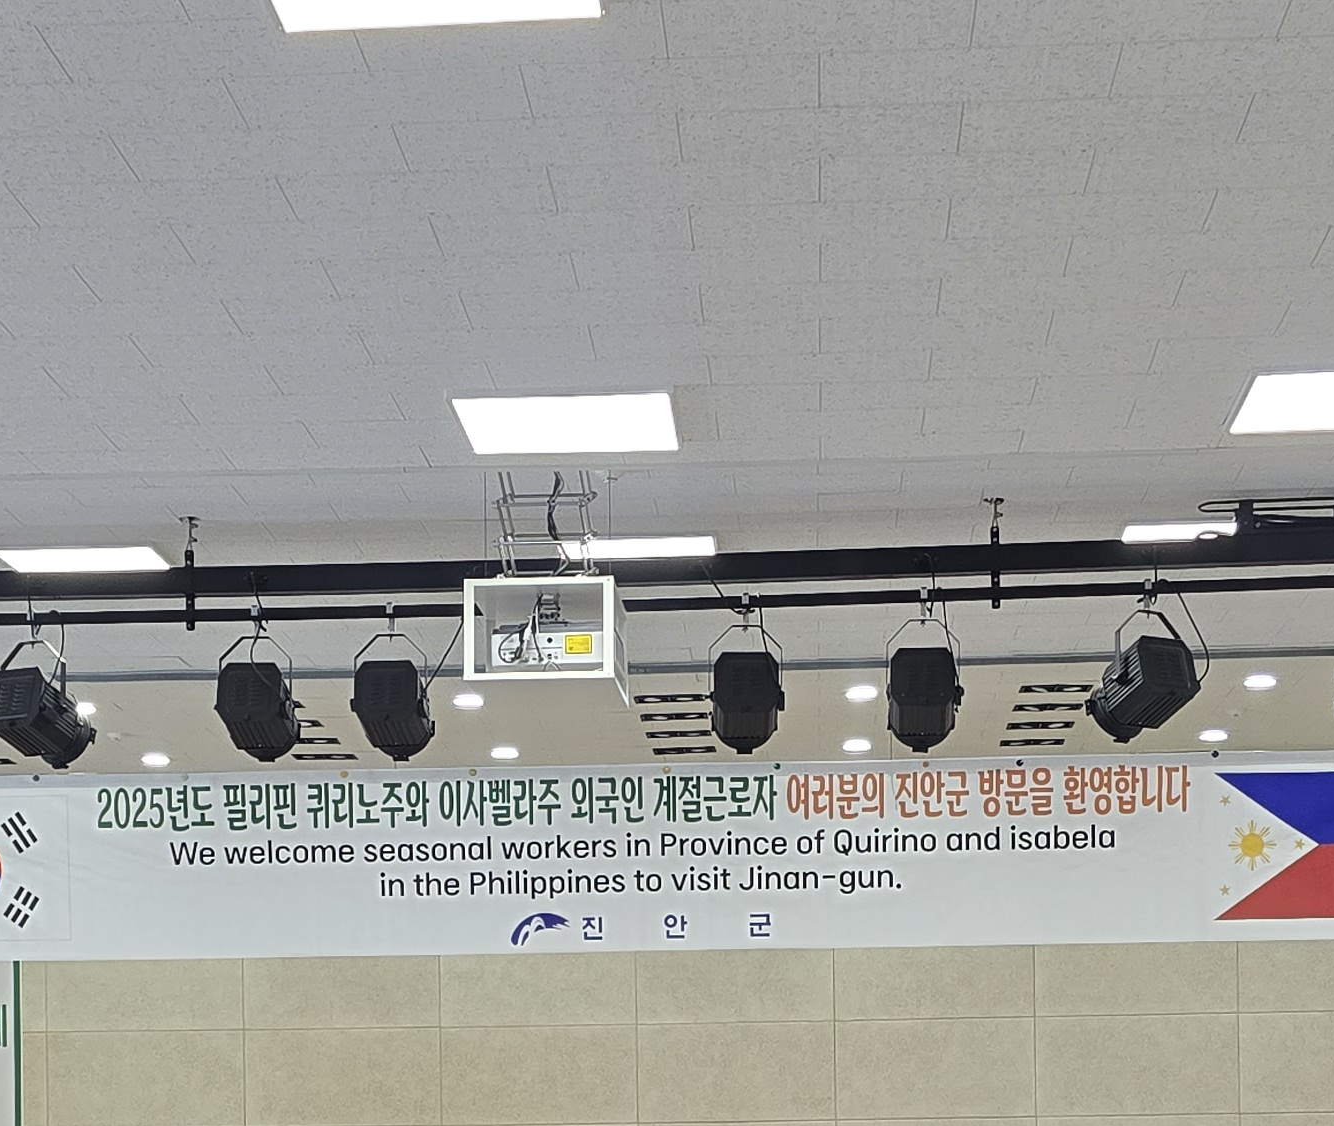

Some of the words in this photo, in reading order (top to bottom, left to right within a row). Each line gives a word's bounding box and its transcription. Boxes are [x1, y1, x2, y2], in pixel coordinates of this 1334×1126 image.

[98, 785, 215, 831] 2025년도
[223, 783, 297, 830] 필리핀
[307, 781, 429, 828] 퀴리노주와
[440, 779, 561, 826] 이사벨라주
[571, 776, 644, 824] 외국인
[654, 772, 777, 822] 계절근로자
[787, 773, 884, 820] 여러분의
[895, 771, 969, 818] 진안군
[978, 768, 1053, 816] 방문을
[1064, 765, 1190, 815] 환영합니다
[170, 842, 215, 865] We
[224, 840, 354, 864] welcome
[364, 836, 491, 862] seasonal
[502, 835, 616, 859] workers
[626, 832, 650, 857] in
[661, 831, 787, 856] Province
[797, 829, 825, 854] of
[834, 828, 936, 856] Quirino
[947, 827, 1000, 851] and
[1011, 824, 1114, 850] isabela
[380, 872, 404, 896] in
[413, 872, 459, 896] the
[470, 869, 625, 899] Philippines
[634, 870, 661, 892] to
[671, 866, 730, 891] visit
[739, 865, 901, 894] Jinan-gun.
[583, 917, 602, 940] 진
[664, 915, 687, 939] 안
[750, 914, 771, 937] 군
